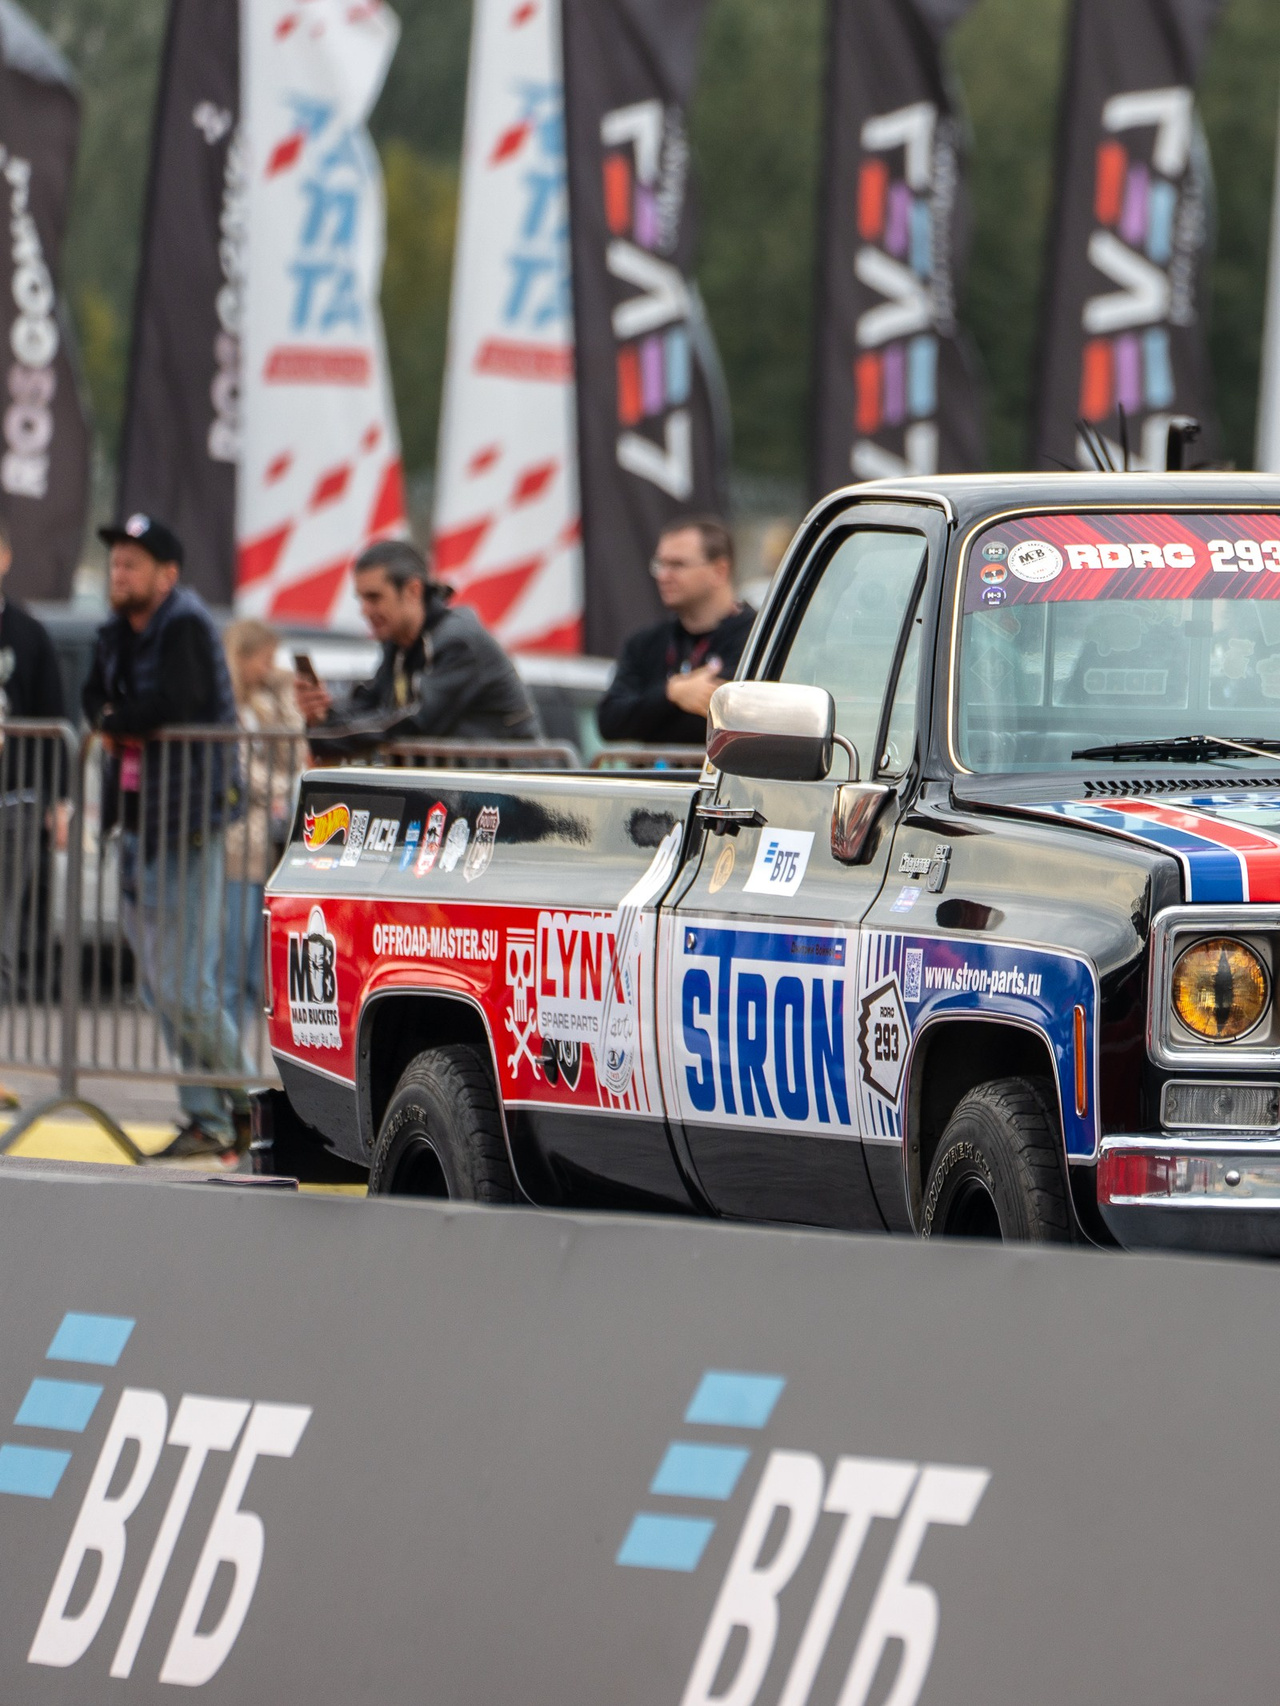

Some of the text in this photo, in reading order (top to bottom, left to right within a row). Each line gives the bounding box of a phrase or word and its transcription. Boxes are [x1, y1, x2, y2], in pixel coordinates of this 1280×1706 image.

[1063, 544, 1196, 570] RDRC
[769, 850, 800, 883] ВТБ
[372, 923, 499, 962] OFFROAD-MASTER.SU
[541, 927, 626, 1005] LYNX
[924, 961, 1042, 999] www.stron-parts.ru
[541, 1011, 599, 1033] SPARE PARTS
[682, 926, 852, 1127] STRON
[874, 1022, 899, 1062] 293
[26, 1386, 314, 1688] ВТБ
[680, 1447, 993, 1706] ВТБ
